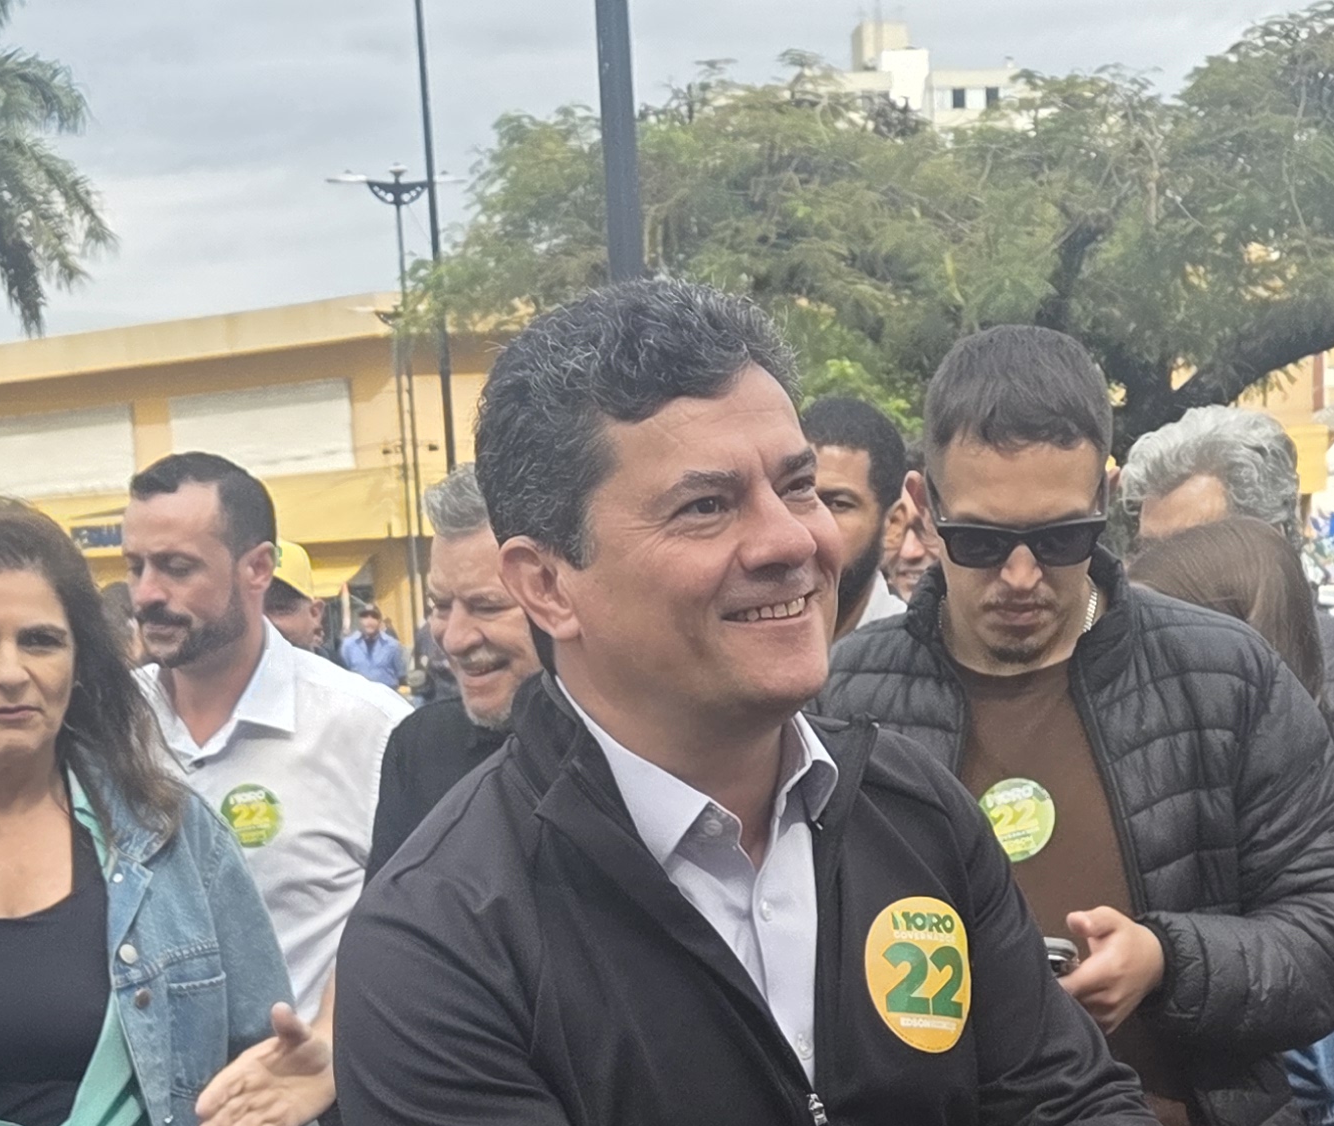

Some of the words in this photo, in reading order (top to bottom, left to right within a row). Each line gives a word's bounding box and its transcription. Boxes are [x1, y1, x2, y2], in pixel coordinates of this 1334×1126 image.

[231, 802, 270, 828] 22
[990, 799, 1039, 836] 22
[891, 911, 955, 934] MORO
[882, 941, 964, 1020] 22
